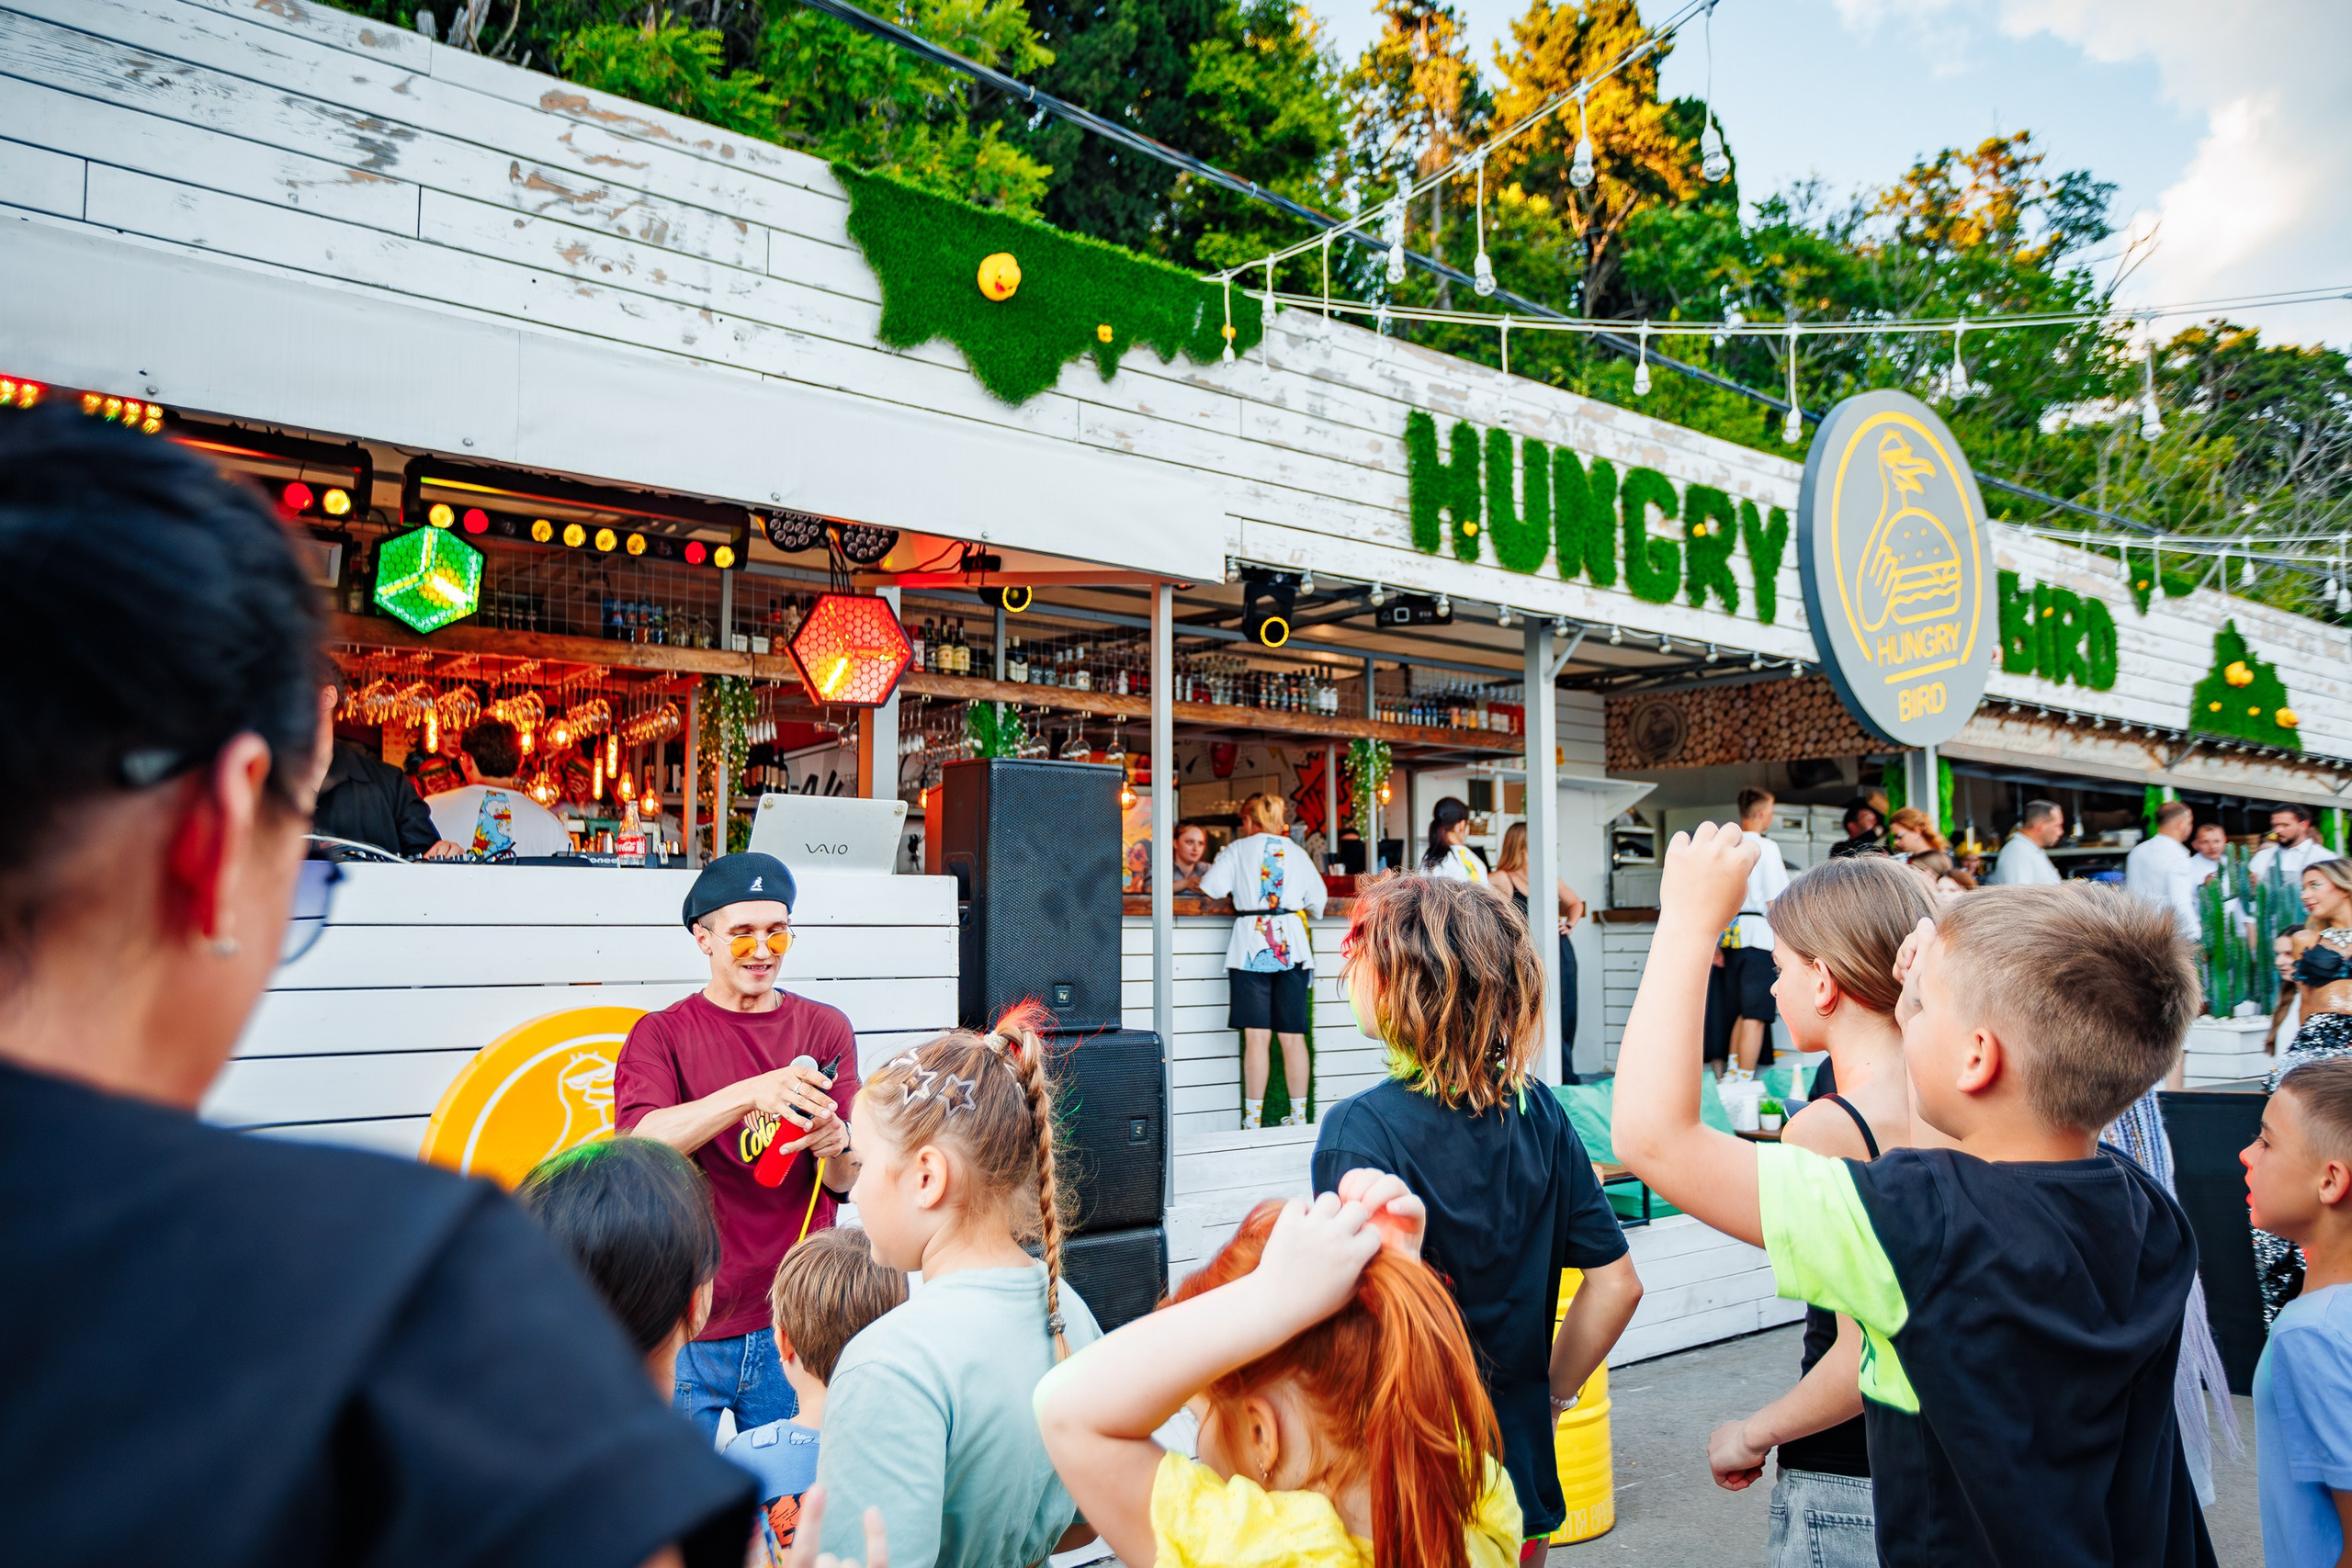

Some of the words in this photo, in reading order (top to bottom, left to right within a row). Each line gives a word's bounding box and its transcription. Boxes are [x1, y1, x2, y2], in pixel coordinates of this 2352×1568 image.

[1405, 410, 1789, 625] HUNGRY
[1997, 570, 2118, 693] BIRD
[1877, 621, 1962, 668] HUNGRY
[1898, 681, 1947, 722] BIRD
[805, 843, 848, 855] VAIO
